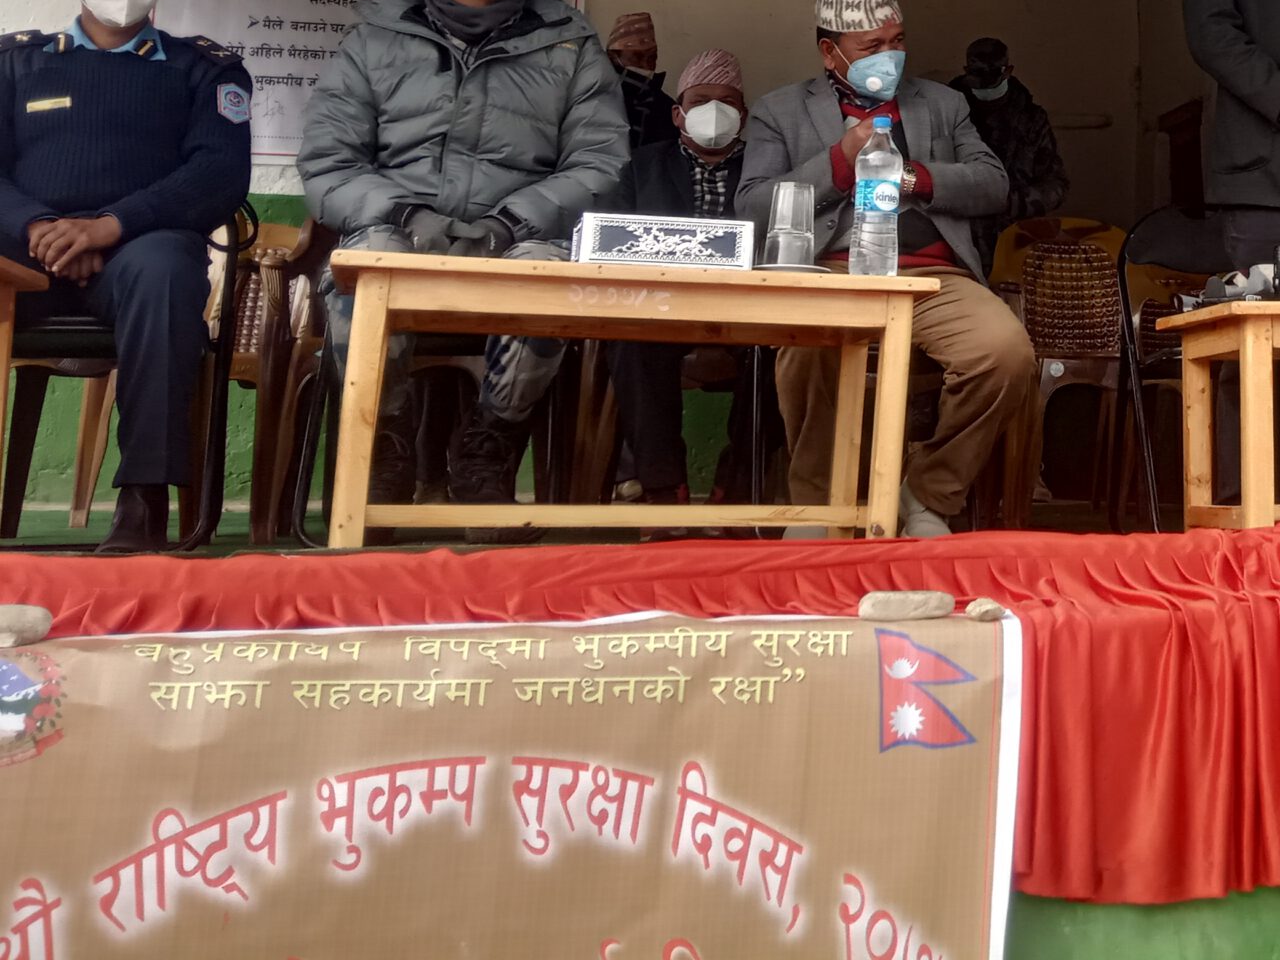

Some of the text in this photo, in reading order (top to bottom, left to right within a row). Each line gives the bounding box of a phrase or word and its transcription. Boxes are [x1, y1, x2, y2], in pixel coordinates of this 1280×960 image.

[750, 629, 854, 667] सुरक्षा
[292, 669, 493, 709] सहकार्यमा
[512, 666, 692, 706] जनधनको
[316, 755, 486, 871] भुकम्प
[511, 755, 654, 855] सुरक्षा
[671, 760, 805, 934] दिवस,
